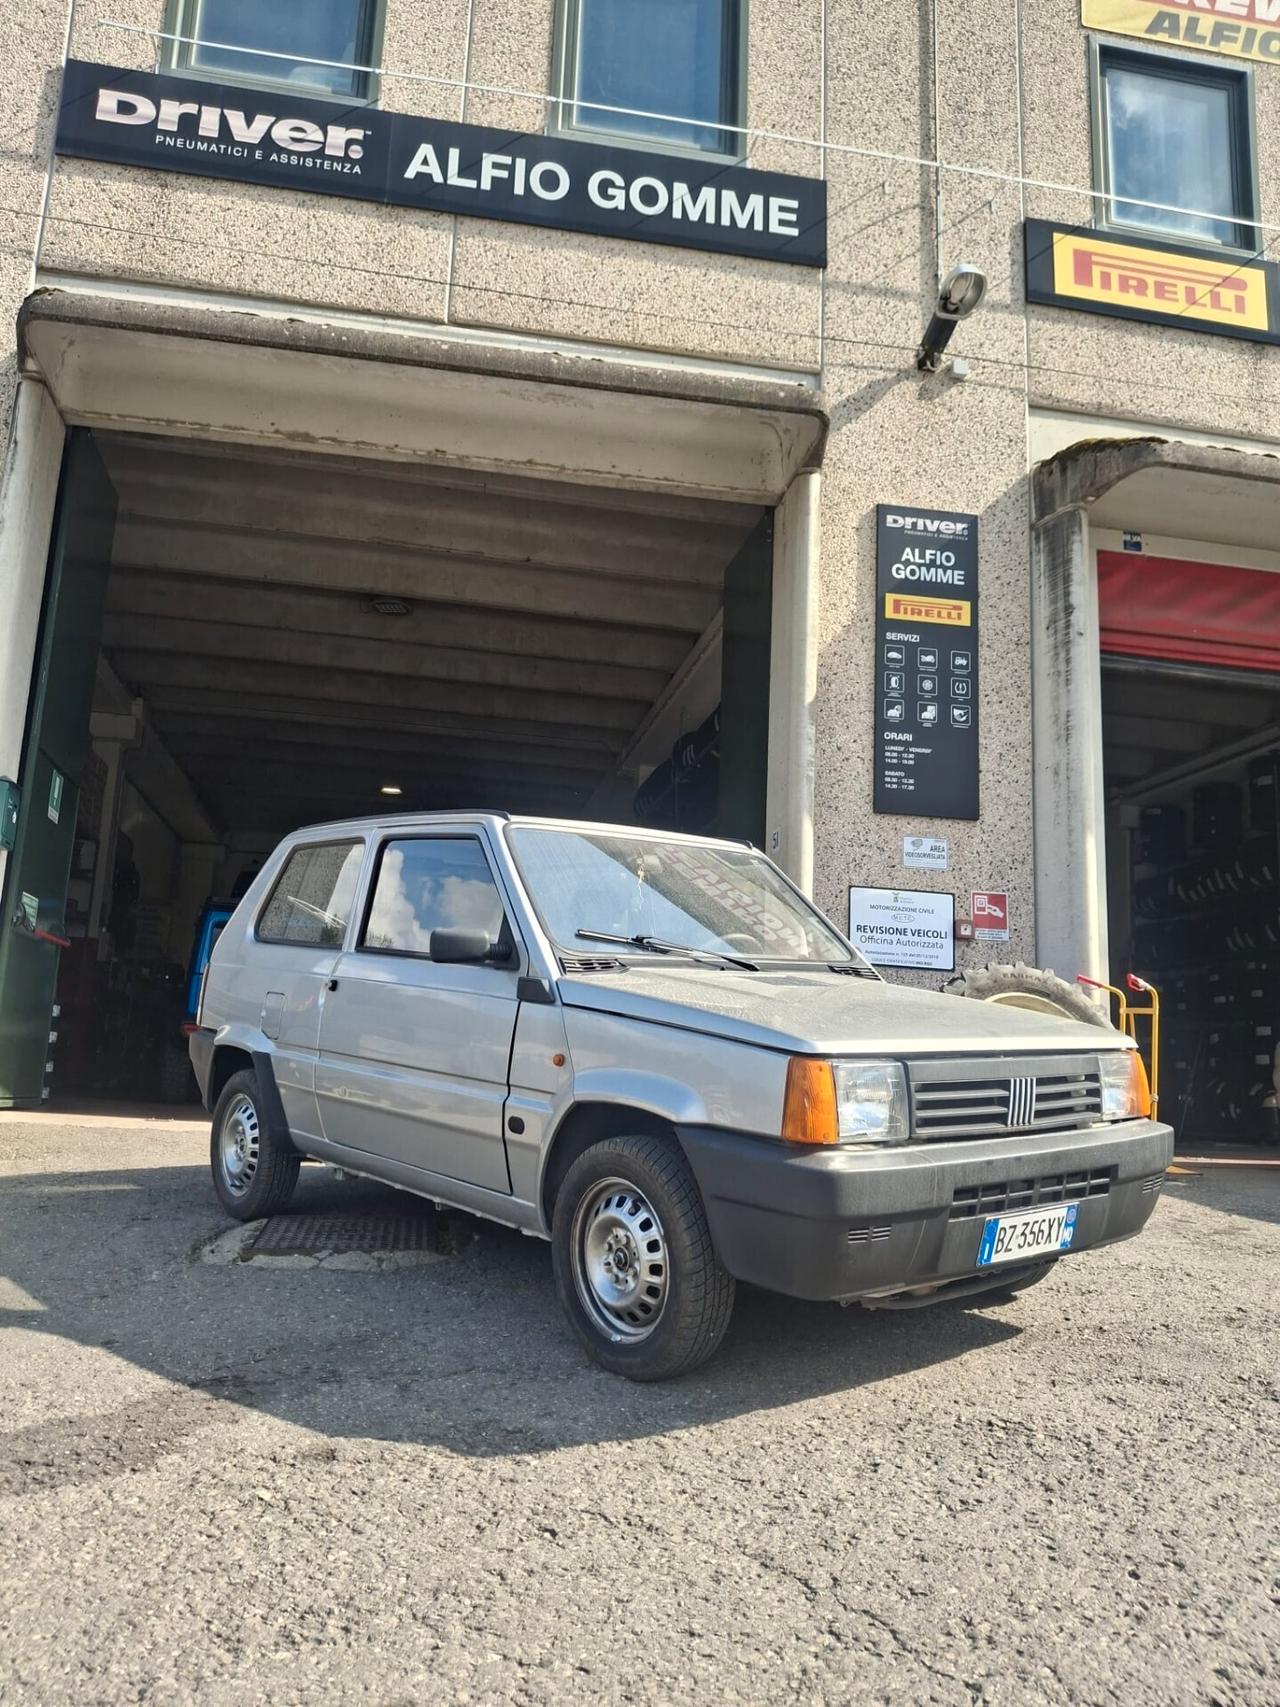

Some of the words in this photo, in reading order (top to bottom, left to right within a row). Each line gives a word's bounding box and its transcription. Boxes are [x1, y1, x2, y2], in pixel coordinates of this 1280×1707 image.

[155, 135, 248, 158] PNEUMATICI
[255, 150, 263, 160] E
[269, 153, 362, 175] ASSISTENZA
[403, 143, 571, 201] ALFIO
[587, 169, 800, 237] GOMME
[1072, 248, 1248, 315] PIRELLI
[901, 547, 956, 567] ALFIO
[891, 563, 965, 586] GOMME
[892, 598, 963, 621] PIRELLI
[885, 632, 920, 643] SERVIZI
[884, 731, 913, 742] ORARI
[930, 844, 946, 853] AREA
[869, 904, 918, 913] MOTORIZZAZIONE
[918, 907, 935, 915] CIVILE
[856, 924, 909, 937] REVISIONE
[910, 928, 948, 940] VEICOLI
[859, 934, 894, 946] Officina
[896, 938, 944, 950] Autorizzata
